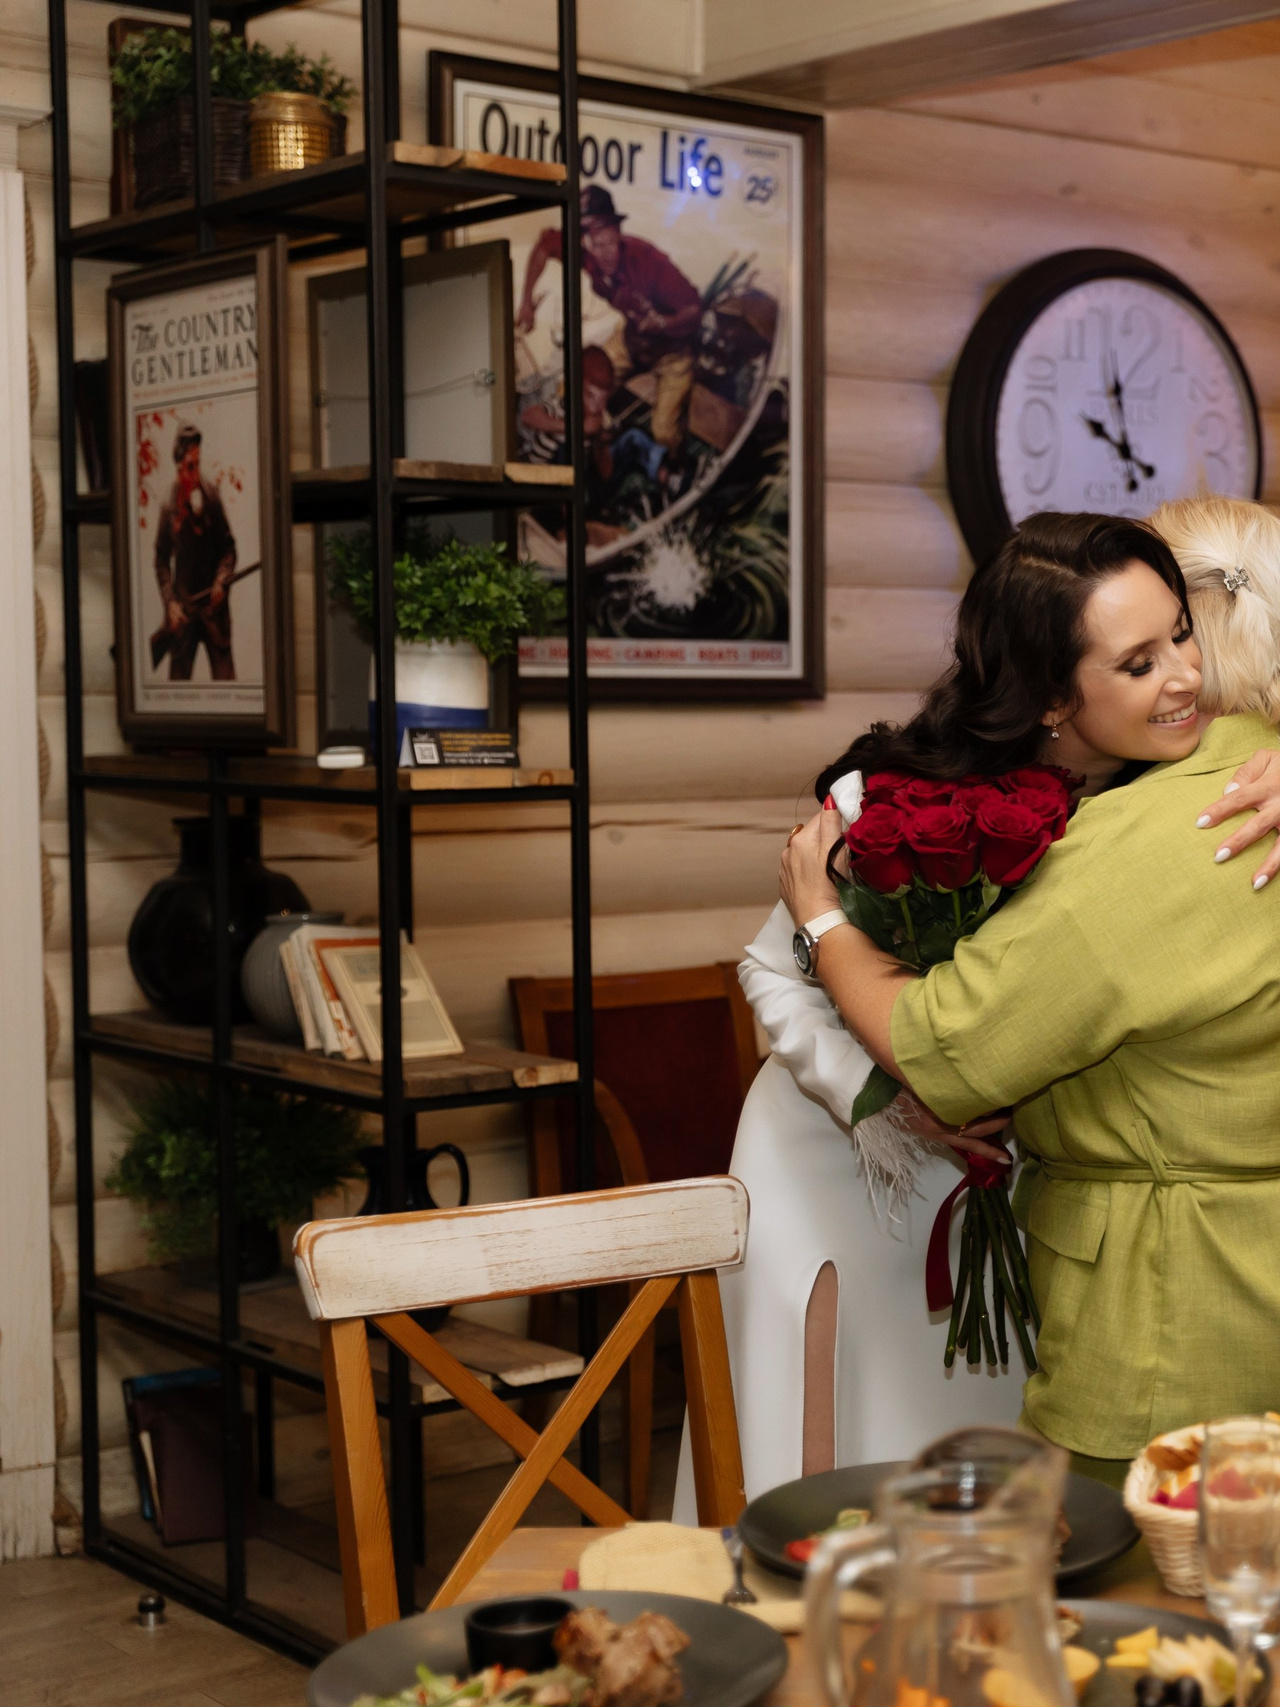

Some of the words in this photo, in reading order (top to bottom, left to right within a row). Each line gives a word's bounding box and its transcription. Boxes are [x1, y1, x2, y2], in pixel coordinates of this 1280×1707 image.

[659, 129, 724, 198] Life
[131, 322, 158, 354] The
[163, 302, 257, 349] COUNTRY
[131, 337, 259, 387] GENTLEMAN
[1016, 397, 1062, 495] 9
[624, 646, 687, 662] CAMPING
[699, 647, 739, 662] BOATS
